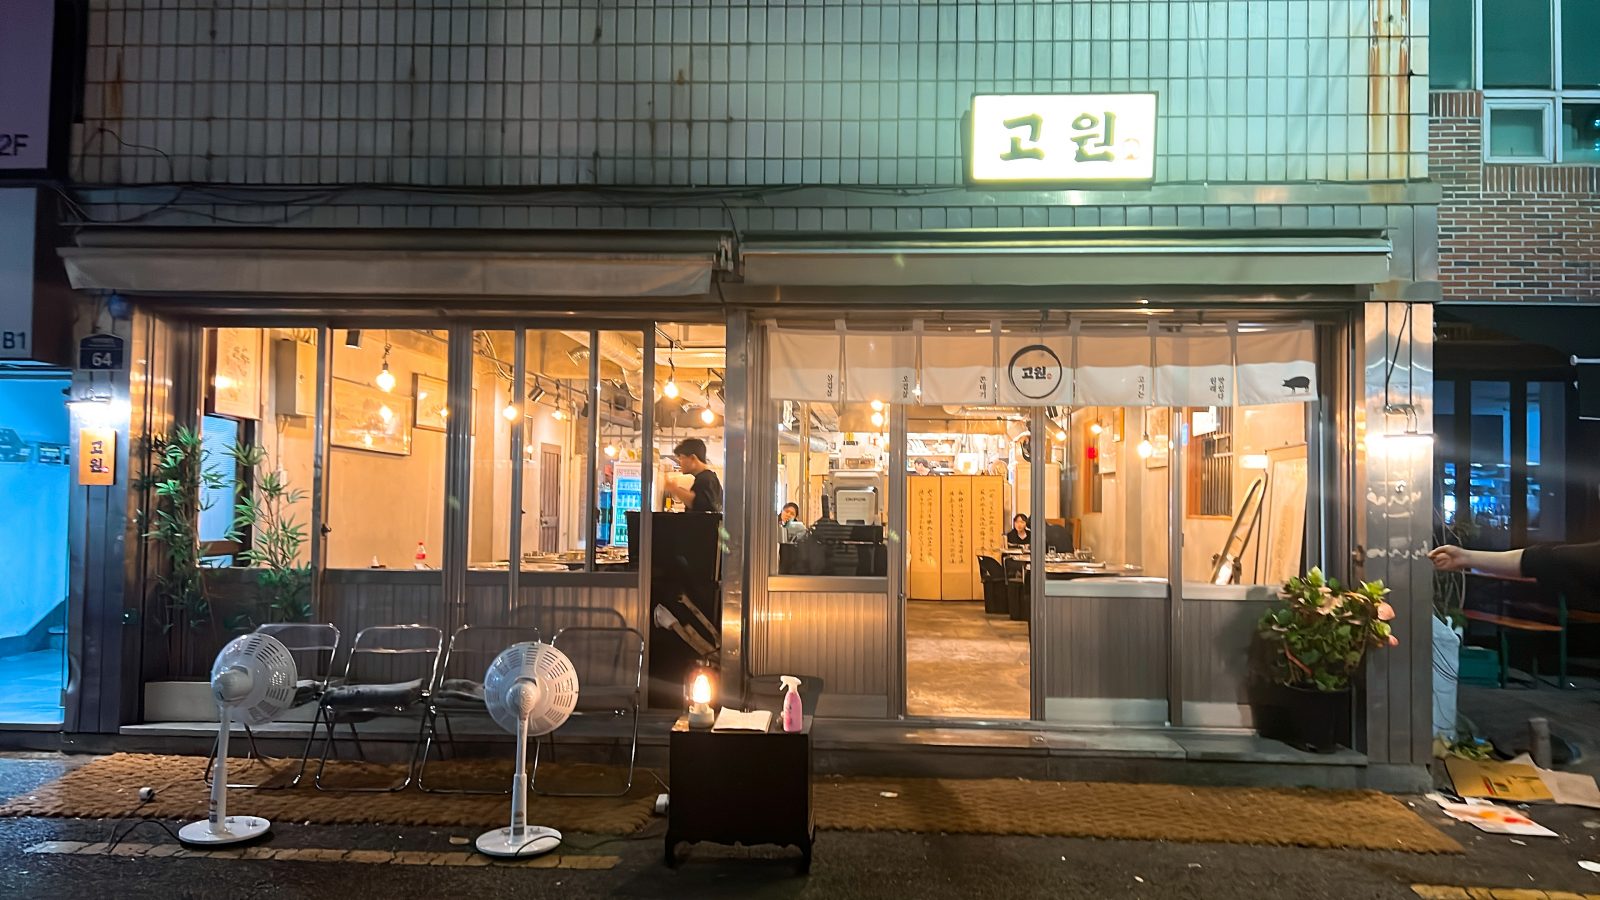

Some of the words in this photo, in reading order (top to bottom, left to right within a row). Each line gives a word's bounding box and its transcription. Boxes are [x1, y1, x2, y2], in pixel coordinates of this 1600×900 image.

[0, 134, 29, 156] 2F
[1000, 111, 1117, 162] 고원
[3, 331, 26, 349] B1
[92, 352, 112, 366] 64
[1022, 366, 1046, 380] 고원
[89, 440, 103, 473] 고원
